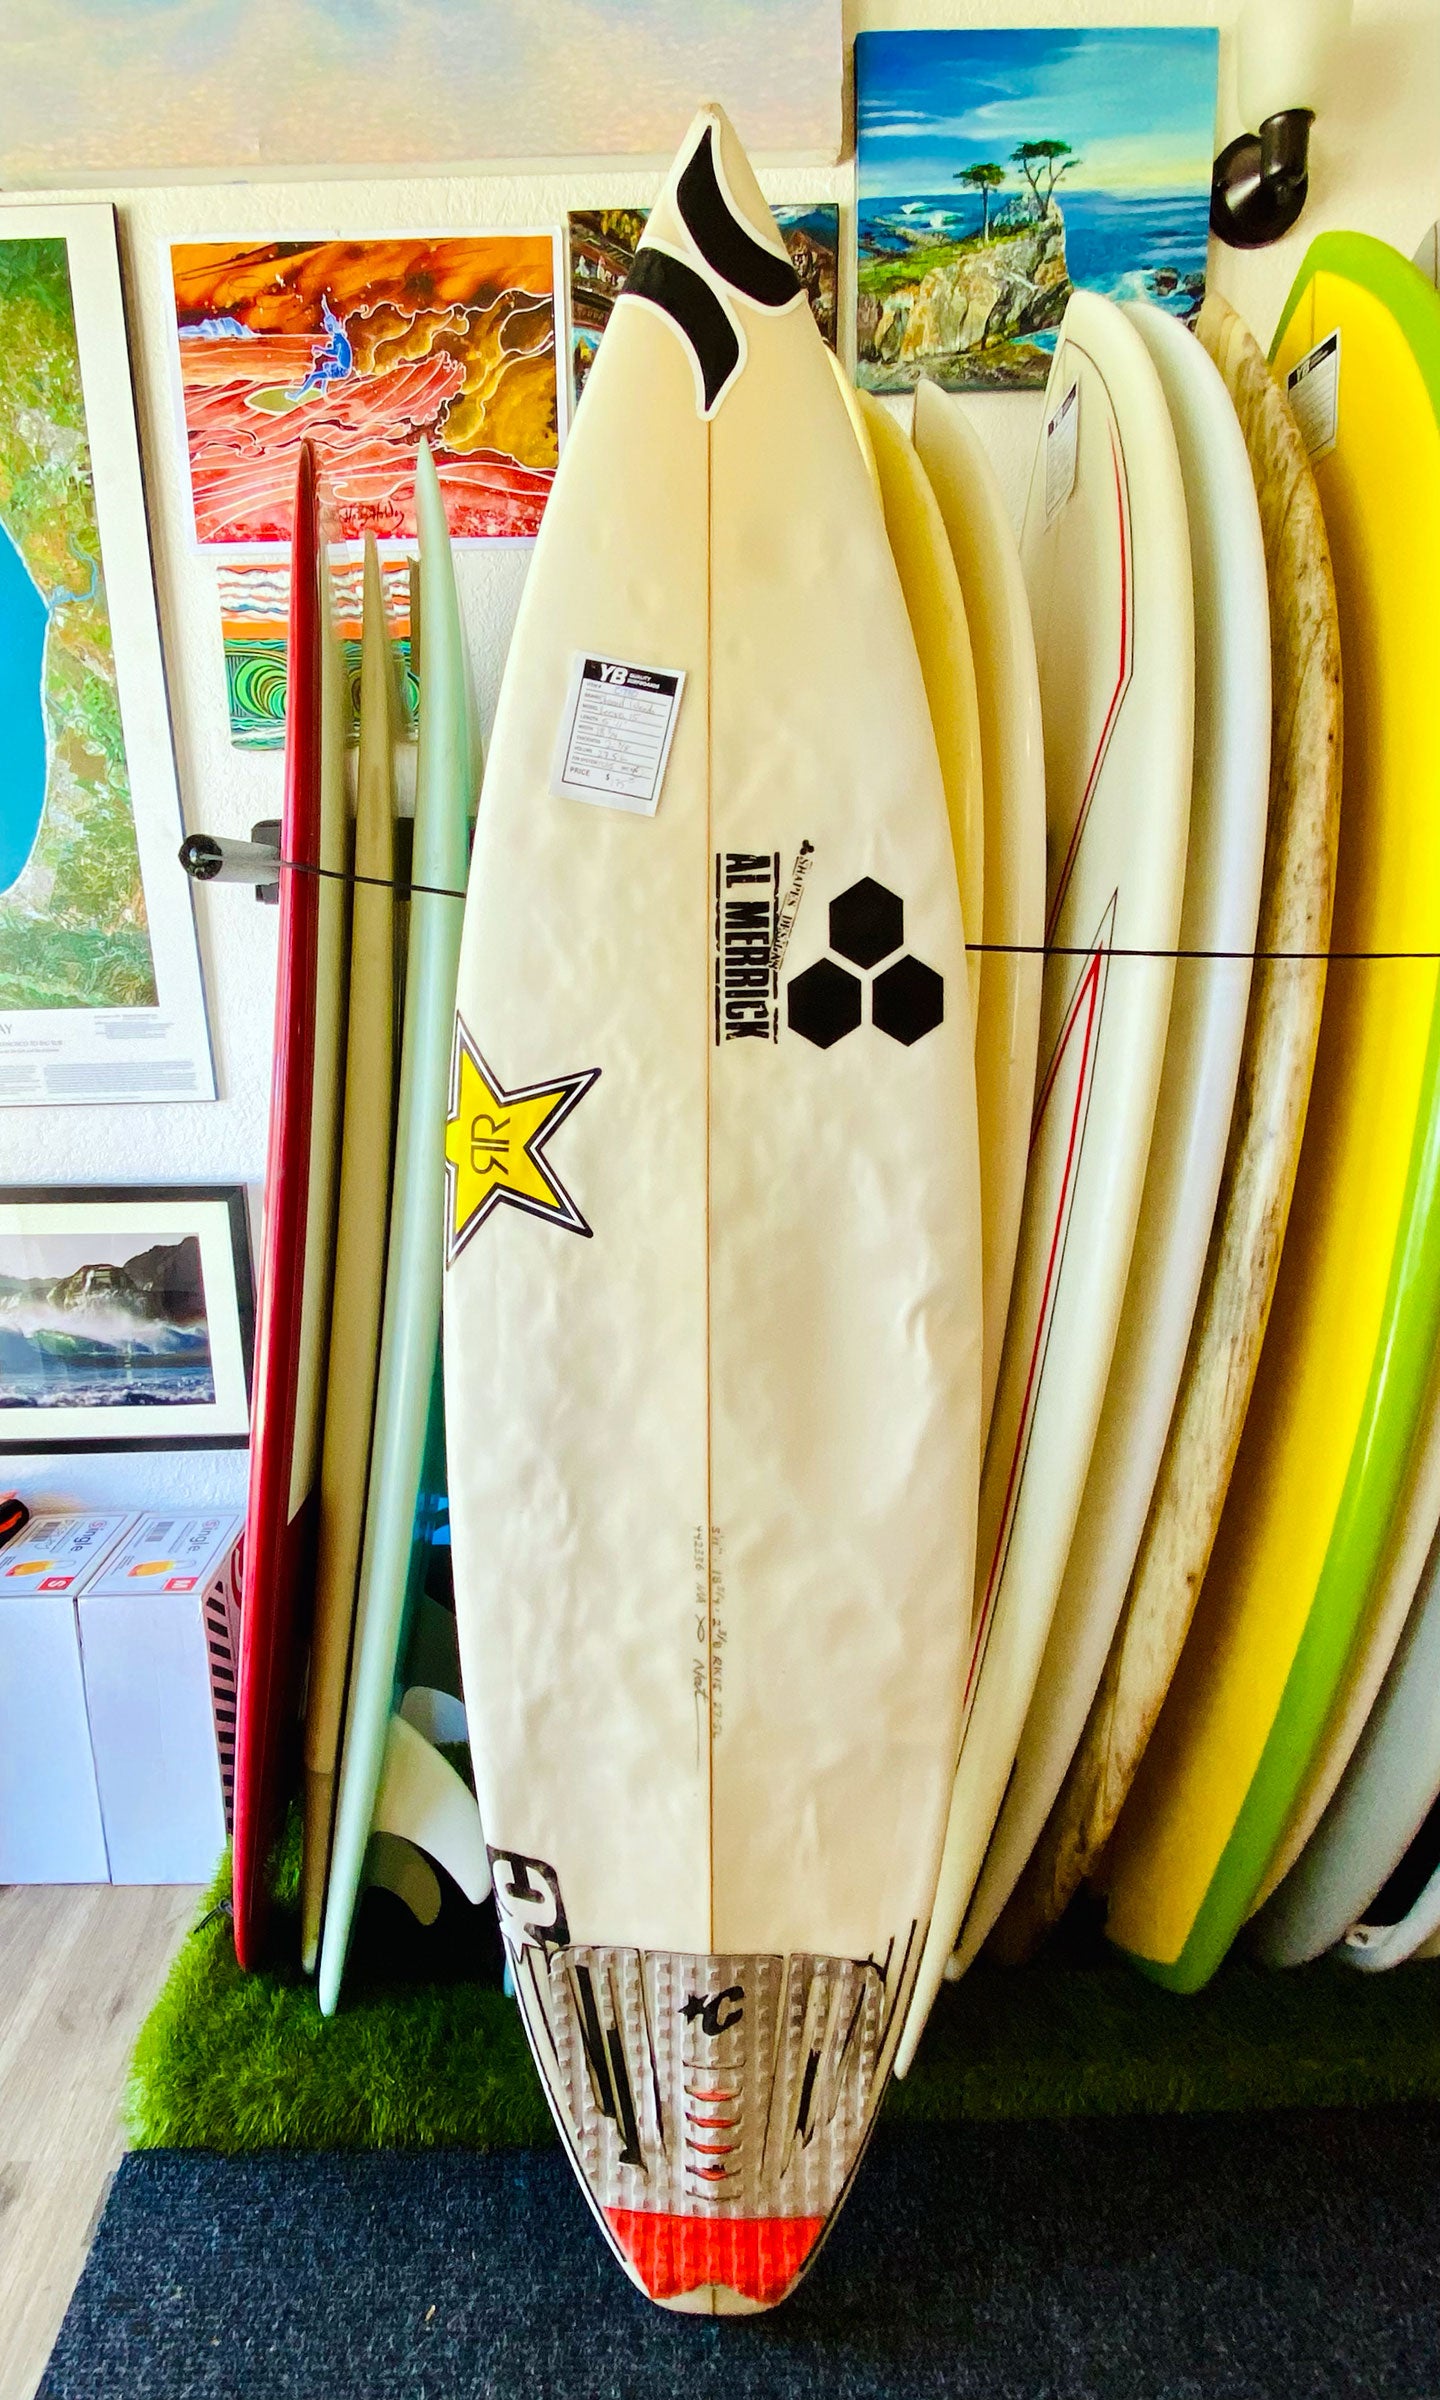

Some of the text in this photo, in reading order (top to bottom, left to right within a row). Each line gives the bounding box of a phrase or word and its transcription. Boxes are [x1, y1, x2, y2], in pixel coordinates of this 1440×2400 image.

[600, 664, 628, 685] YB
[580, 714, 599, 722] LENGTH
[570, 766, 591, 777] PRICE
[725, 853, 771, 1041] AL MERRICK
[48, 1578, 68, 1589] S
[171, 1579, 192, 1589] M
